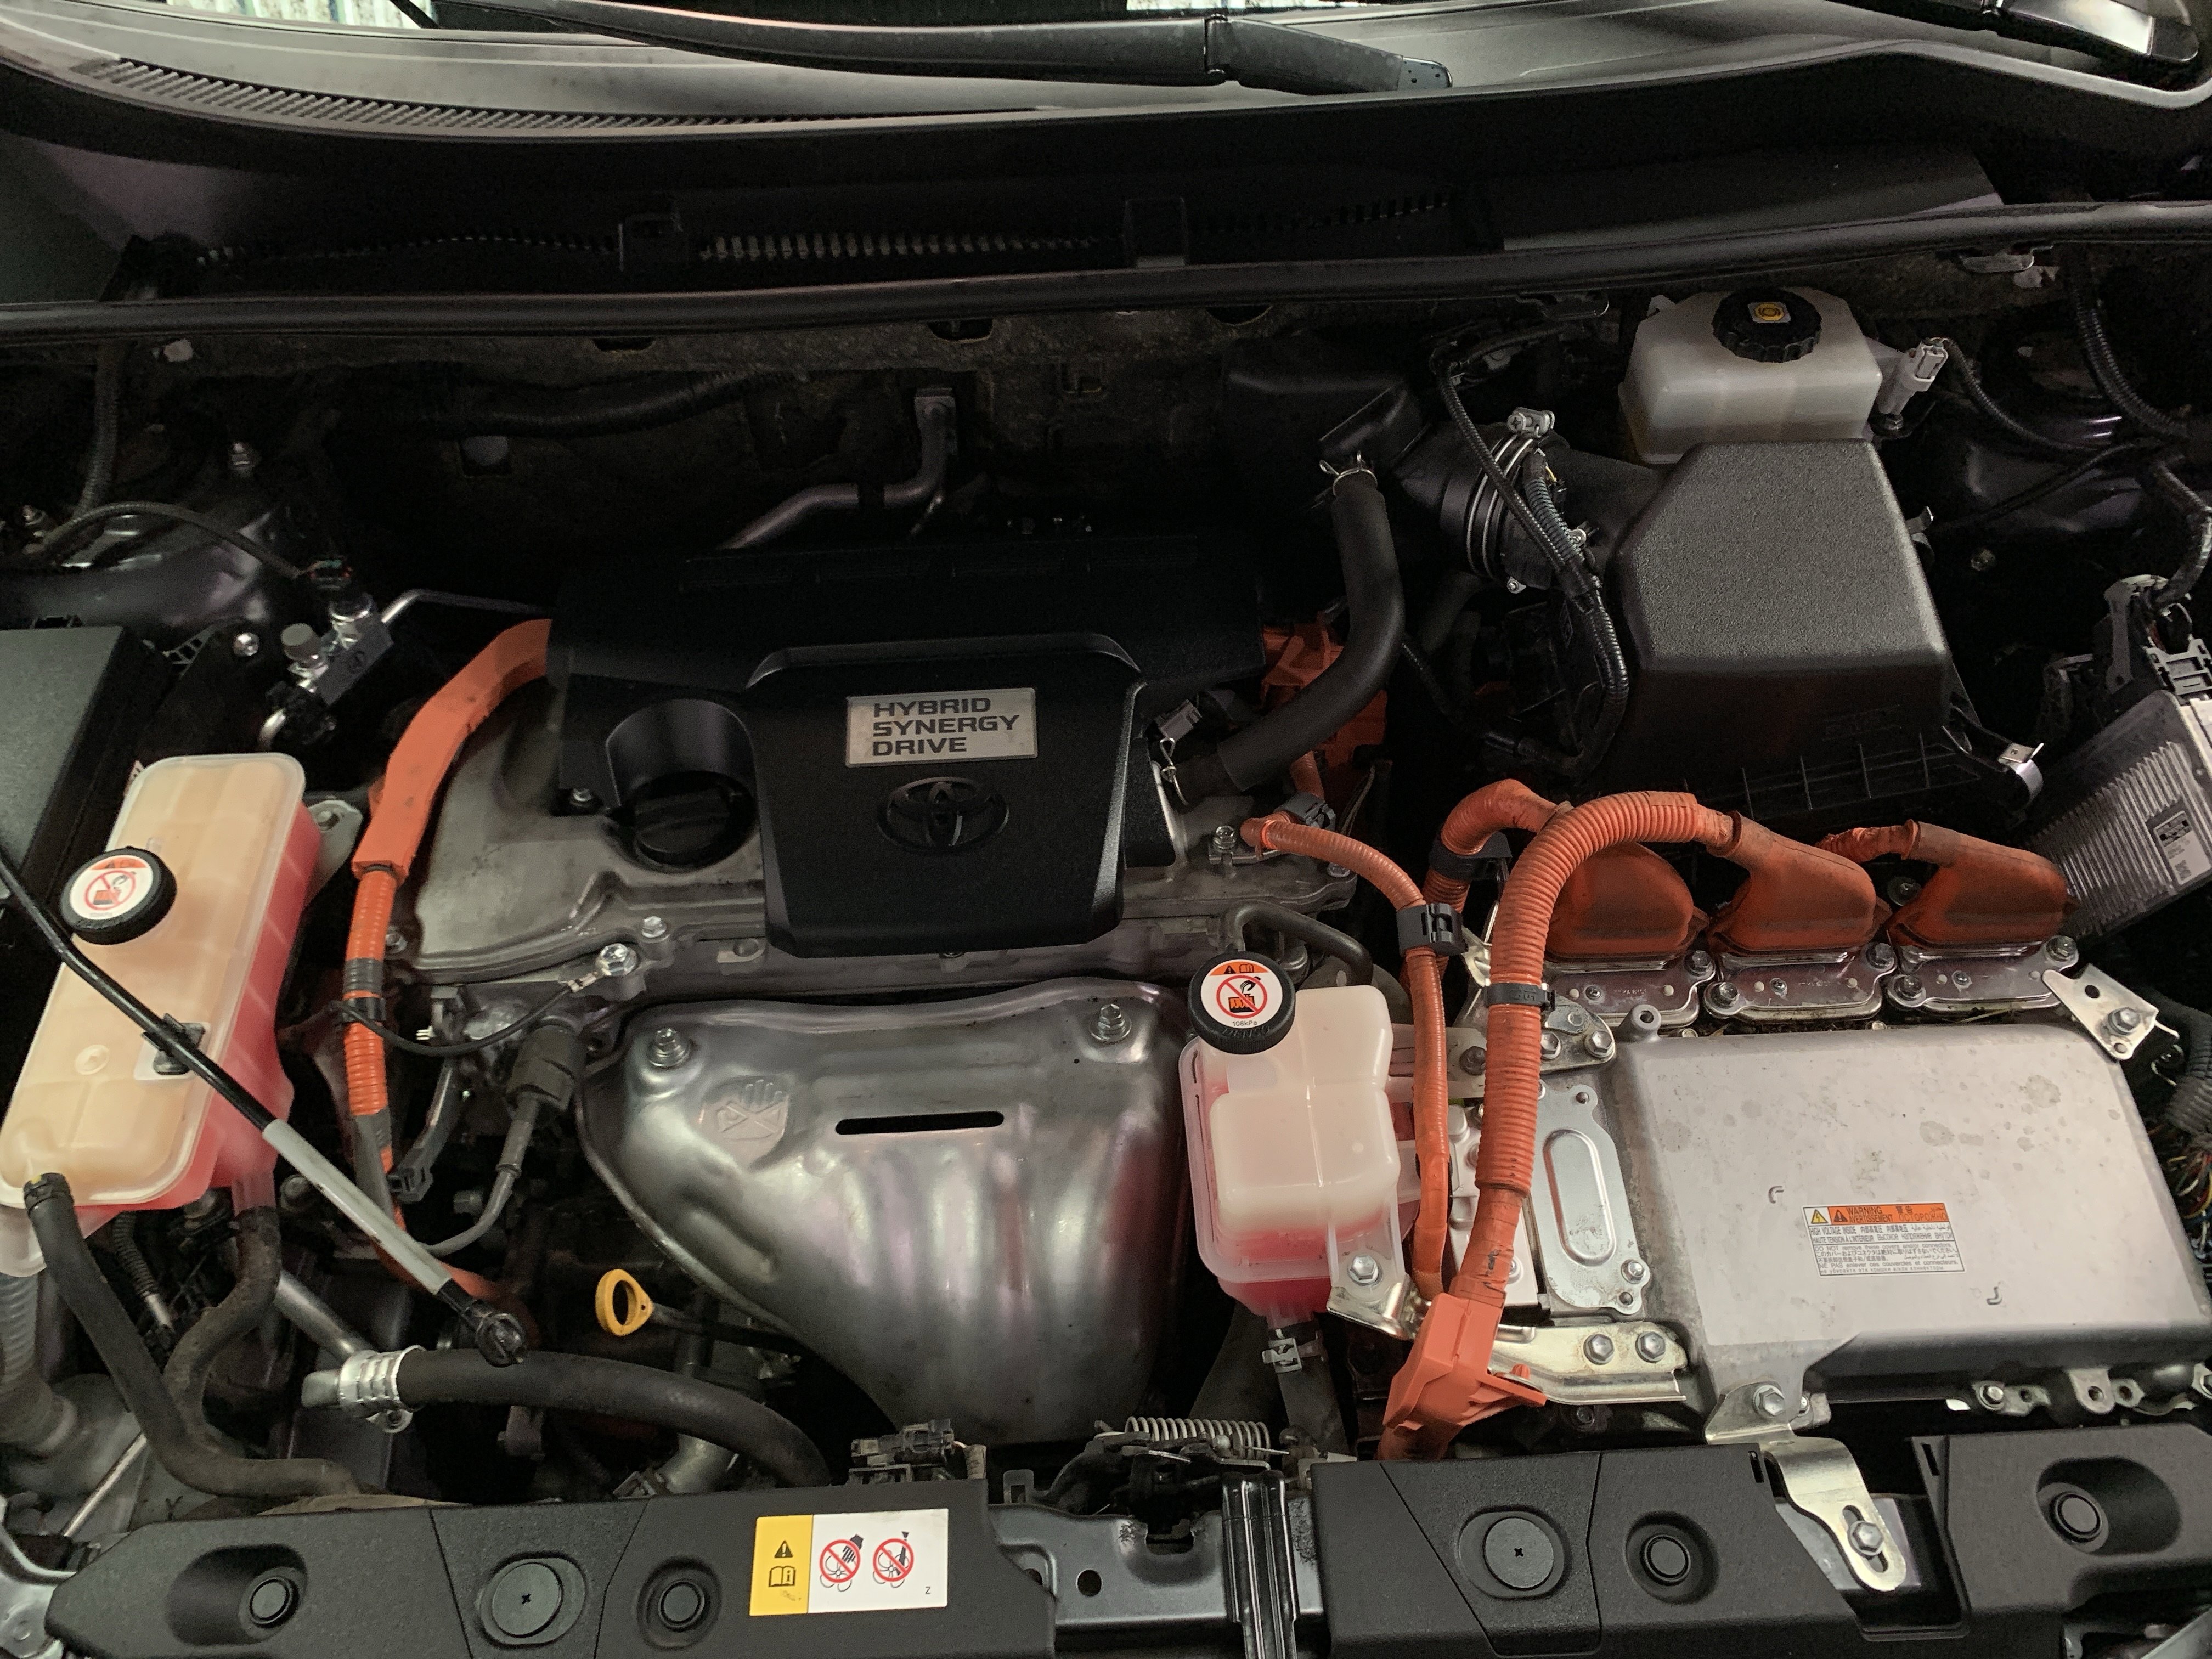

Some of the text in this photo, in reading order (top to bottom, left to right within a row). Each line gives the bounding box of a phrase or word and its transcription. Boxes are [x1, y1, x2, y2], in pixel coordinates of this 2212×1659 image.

[874, 698, 990, 718] HYBRID
[873, 715, 1019, 737] SYNERGY
[873, 737, 967, 756] DRIVE
[1846, 1206, 1882, 1215] WARNING
[1849, 1214, 1893, 1223] AVERTISSEMENT
[1810, 1226, 1857, 1235] HIGH VOLTAGE INSIDE
